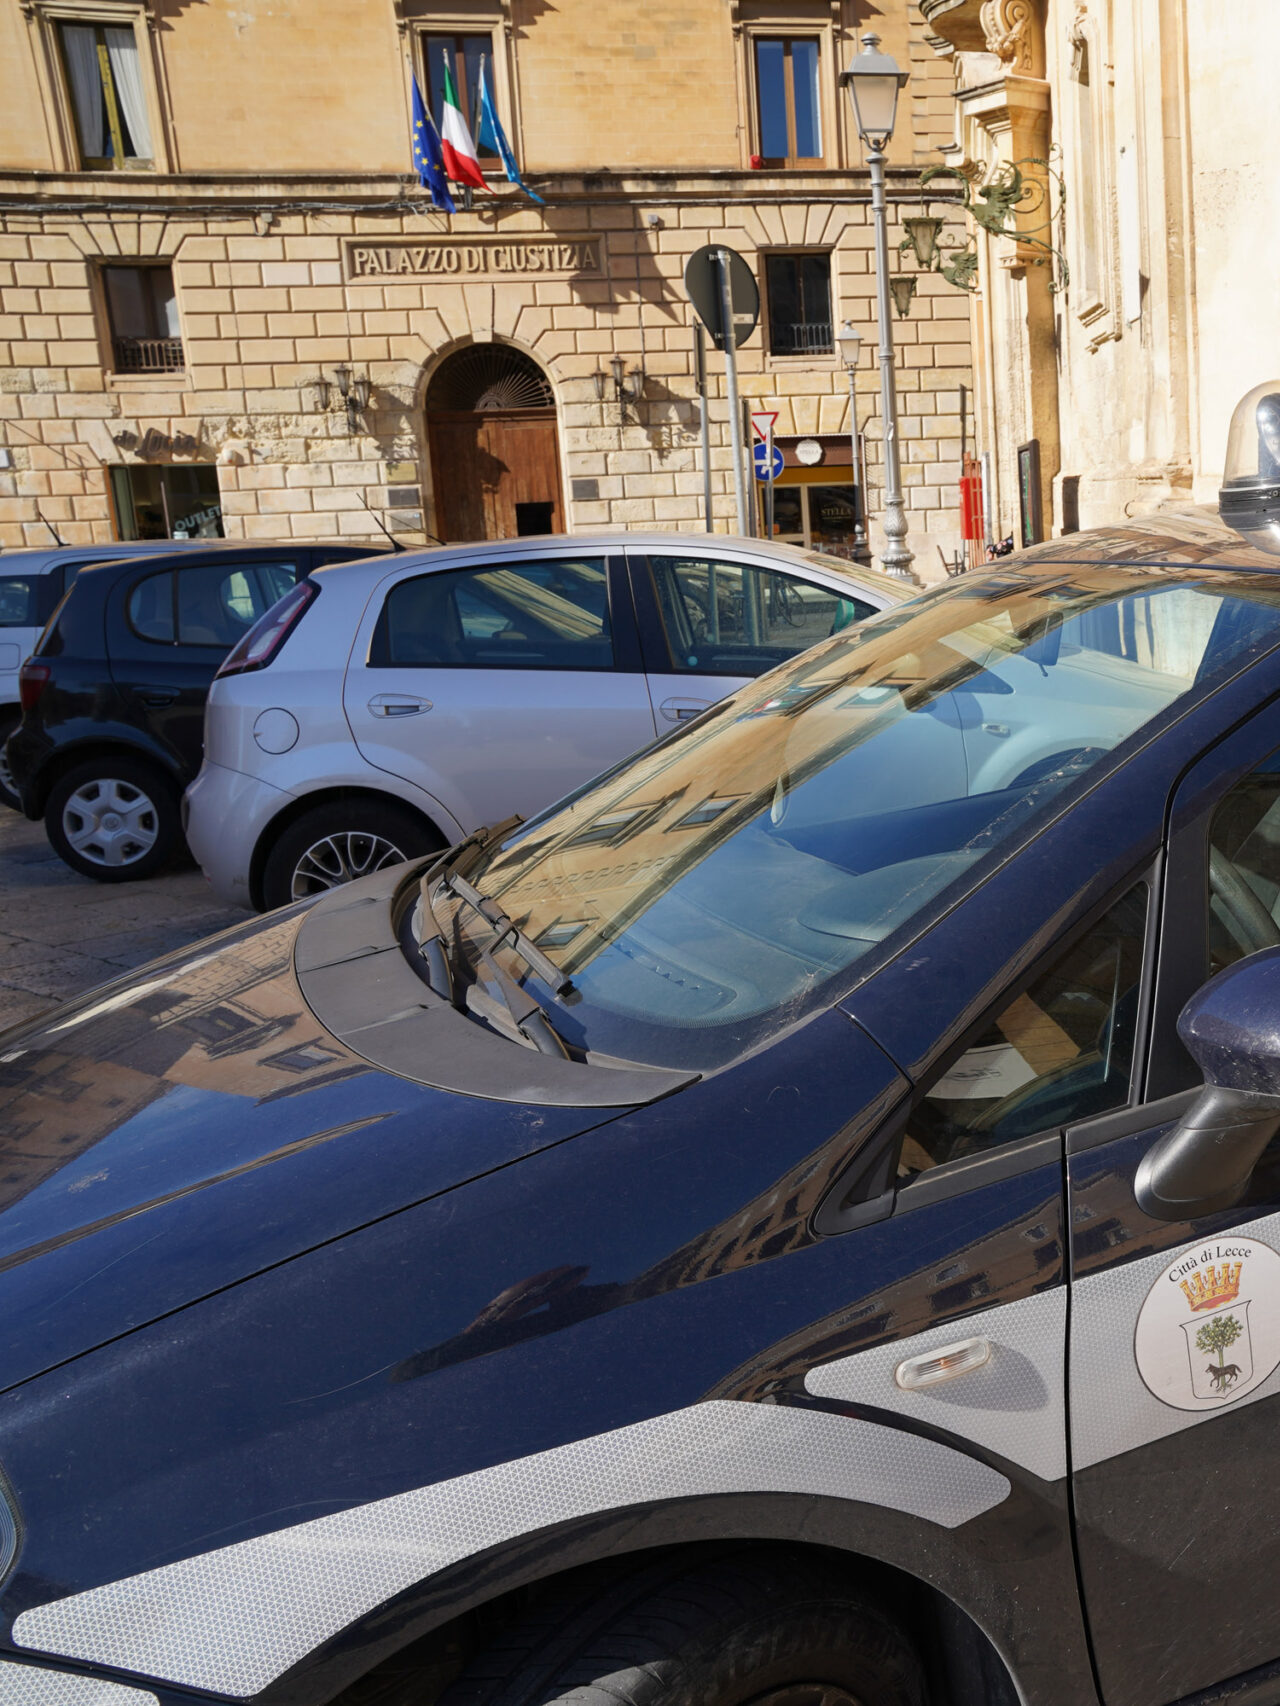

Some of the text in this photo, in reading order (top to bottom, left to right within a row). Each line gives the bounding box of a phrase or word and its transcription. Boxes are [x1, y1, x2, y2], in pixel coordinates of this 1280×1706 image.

[353, 245, 597, 274] PALAZZO DI GIUSTIZIA
[174, 505, 222, 532] OUTLET
[1168, 1246, 1252, 1283] Città di Lecce
